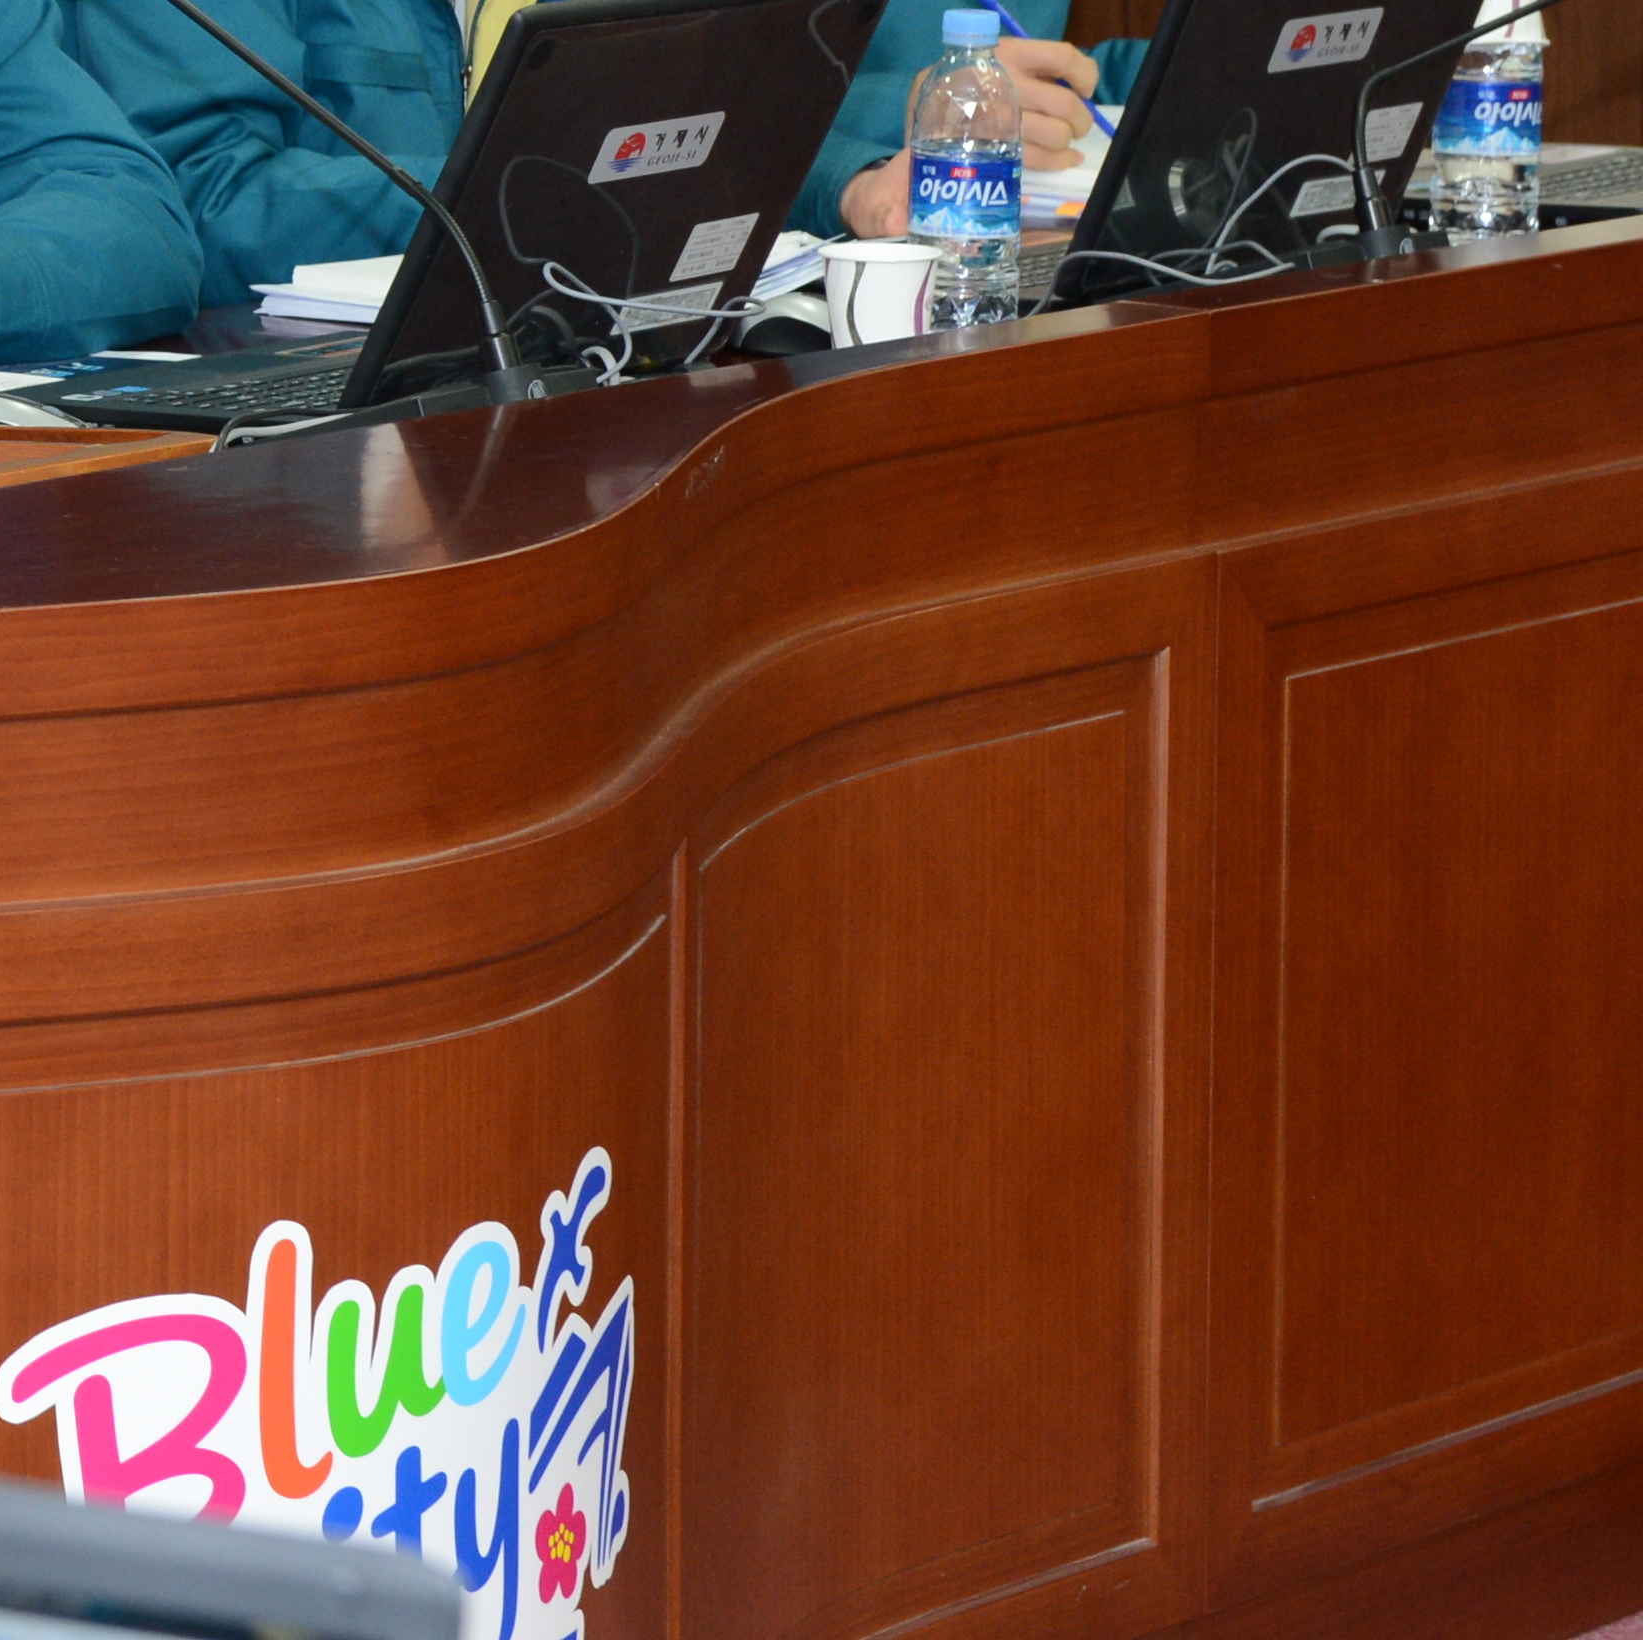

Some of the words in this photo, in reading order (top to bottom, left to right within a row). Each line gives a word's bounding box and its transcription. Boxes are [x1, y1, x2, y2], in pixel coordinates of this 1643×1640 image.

[655, 125, 710, 152] 거제시
[919, 177, 1009, 208] 아이시스
[11, 1237, 527, 1529] Blue
